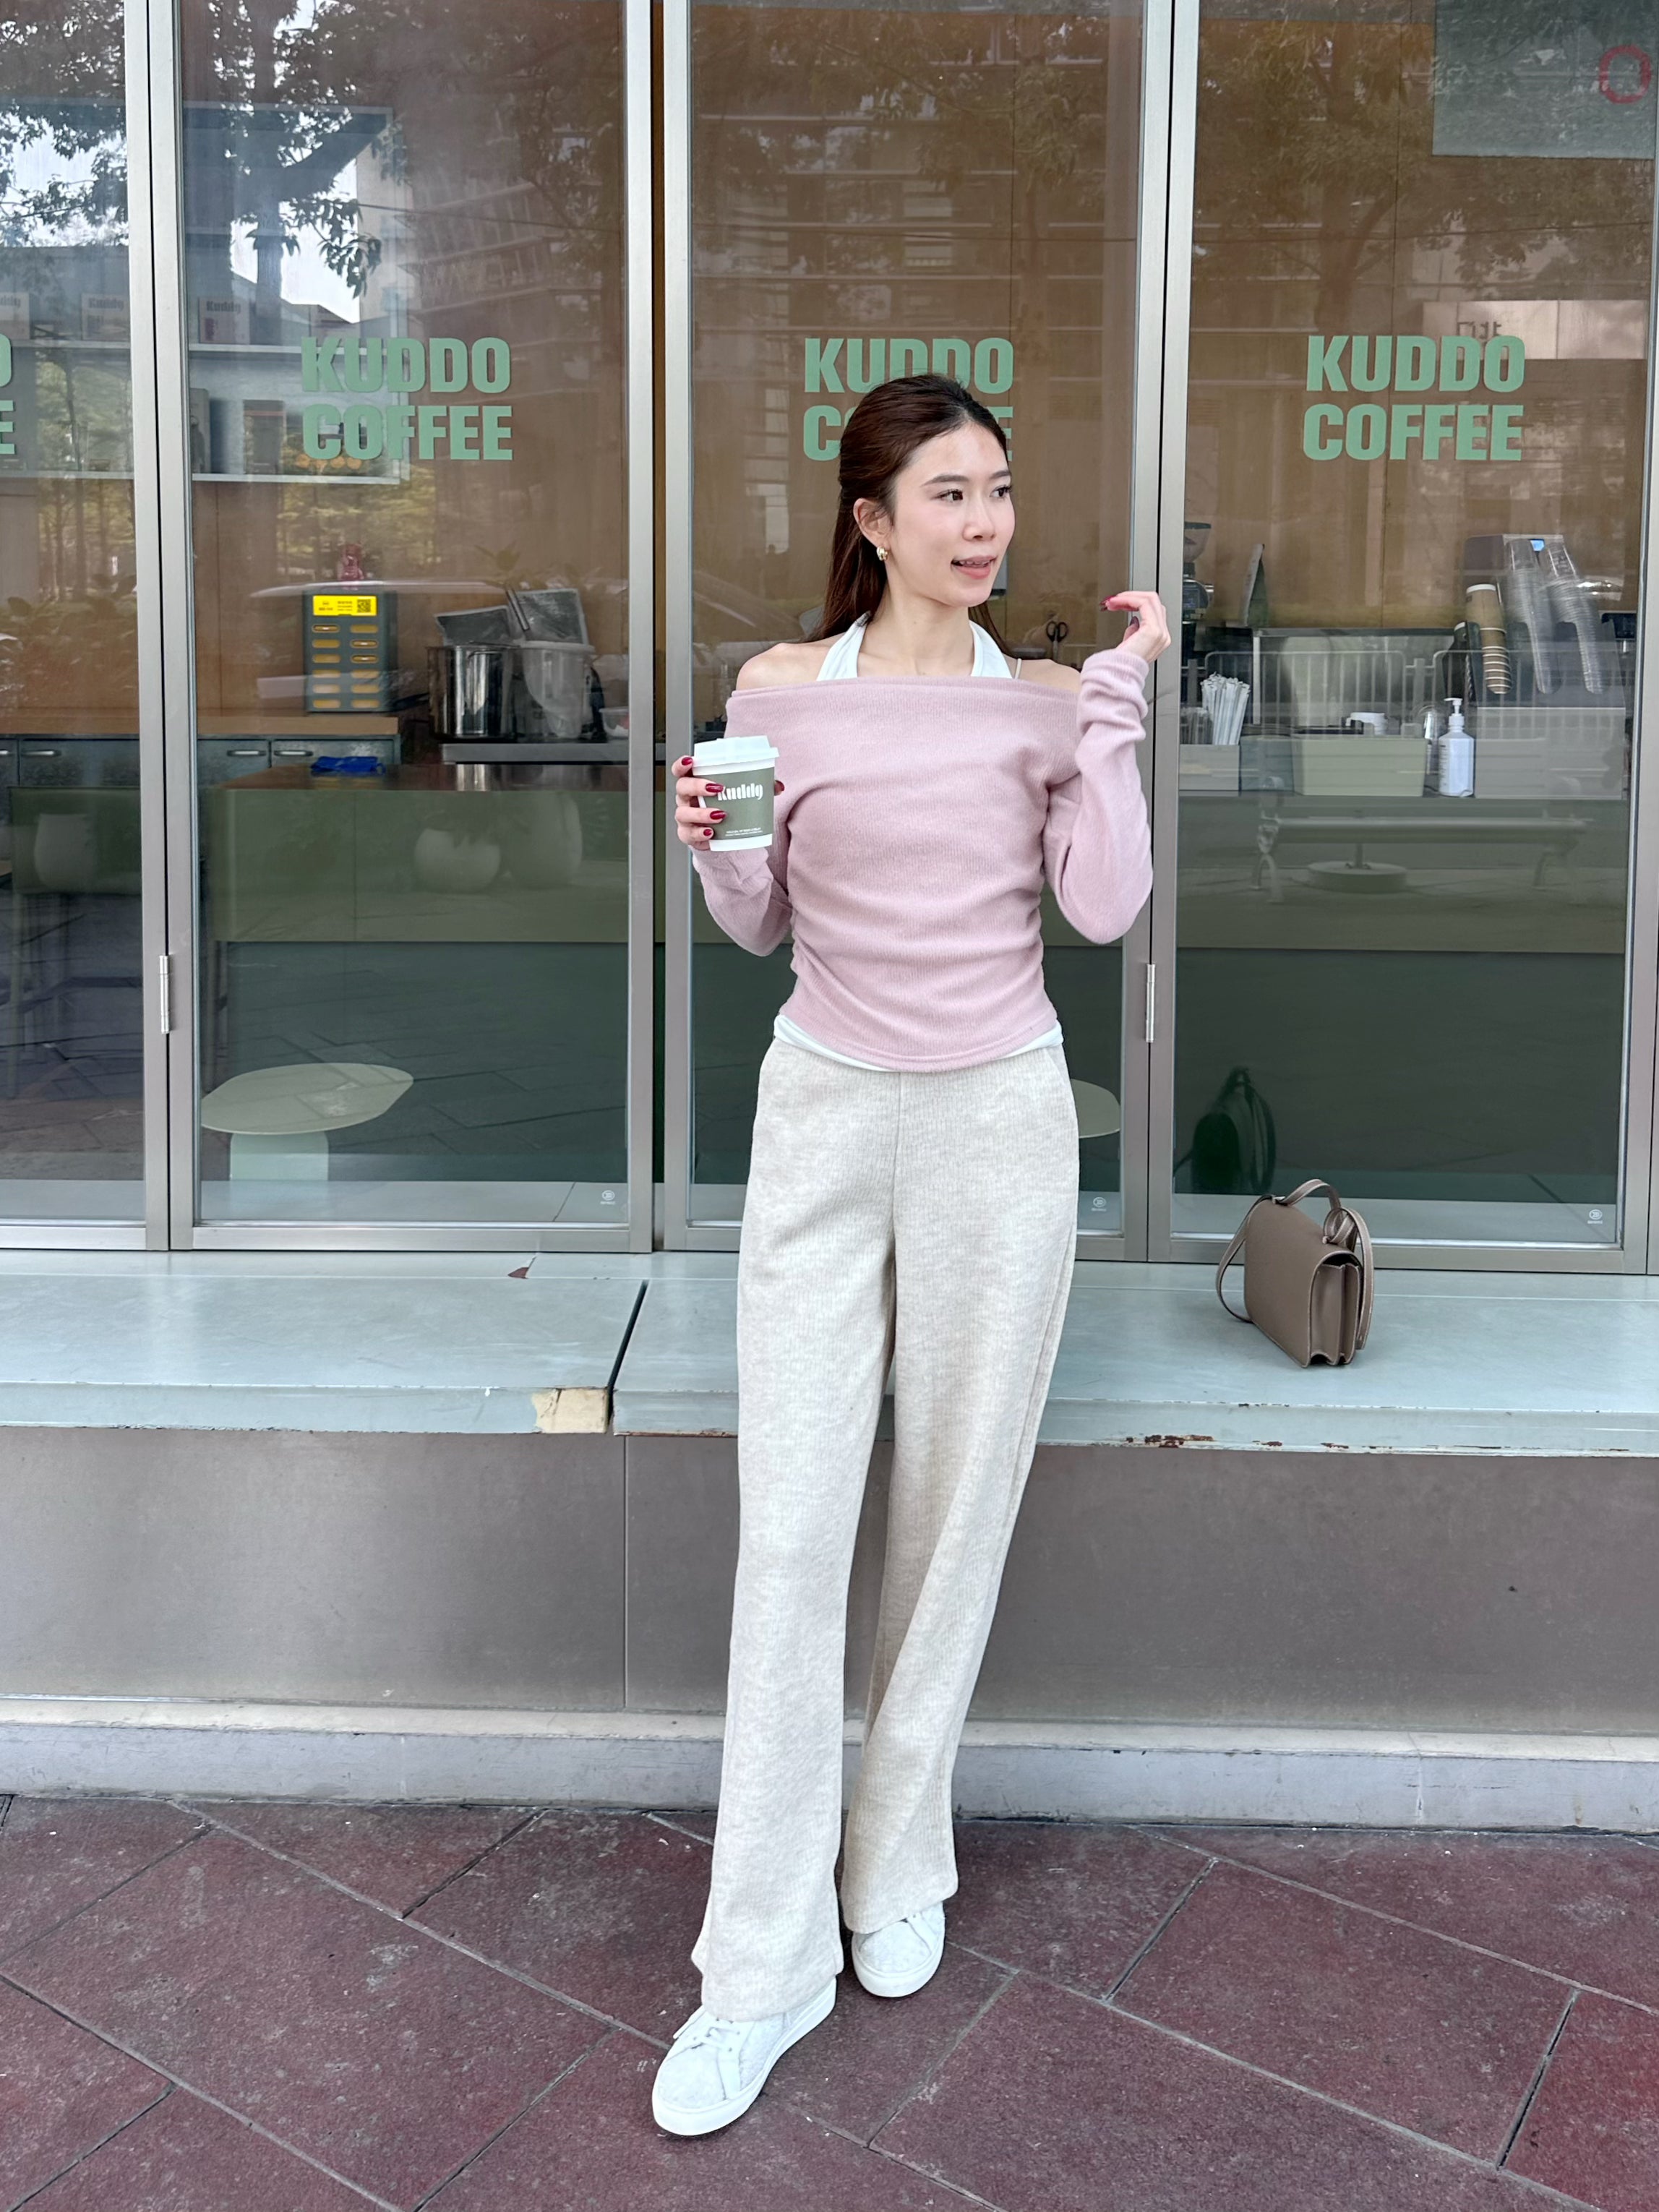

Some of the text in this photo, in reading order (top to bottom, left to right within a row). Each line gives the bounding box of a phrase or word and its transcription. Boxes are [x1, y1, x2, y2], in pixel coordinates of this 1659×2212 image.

[301, 337, 510, 393] KUDDO
[1306, 335, 1525, 393] KUDDO
[302, 403, 513, 460] COFFEE
[1303, 403, 1524, 460] COFFEE
